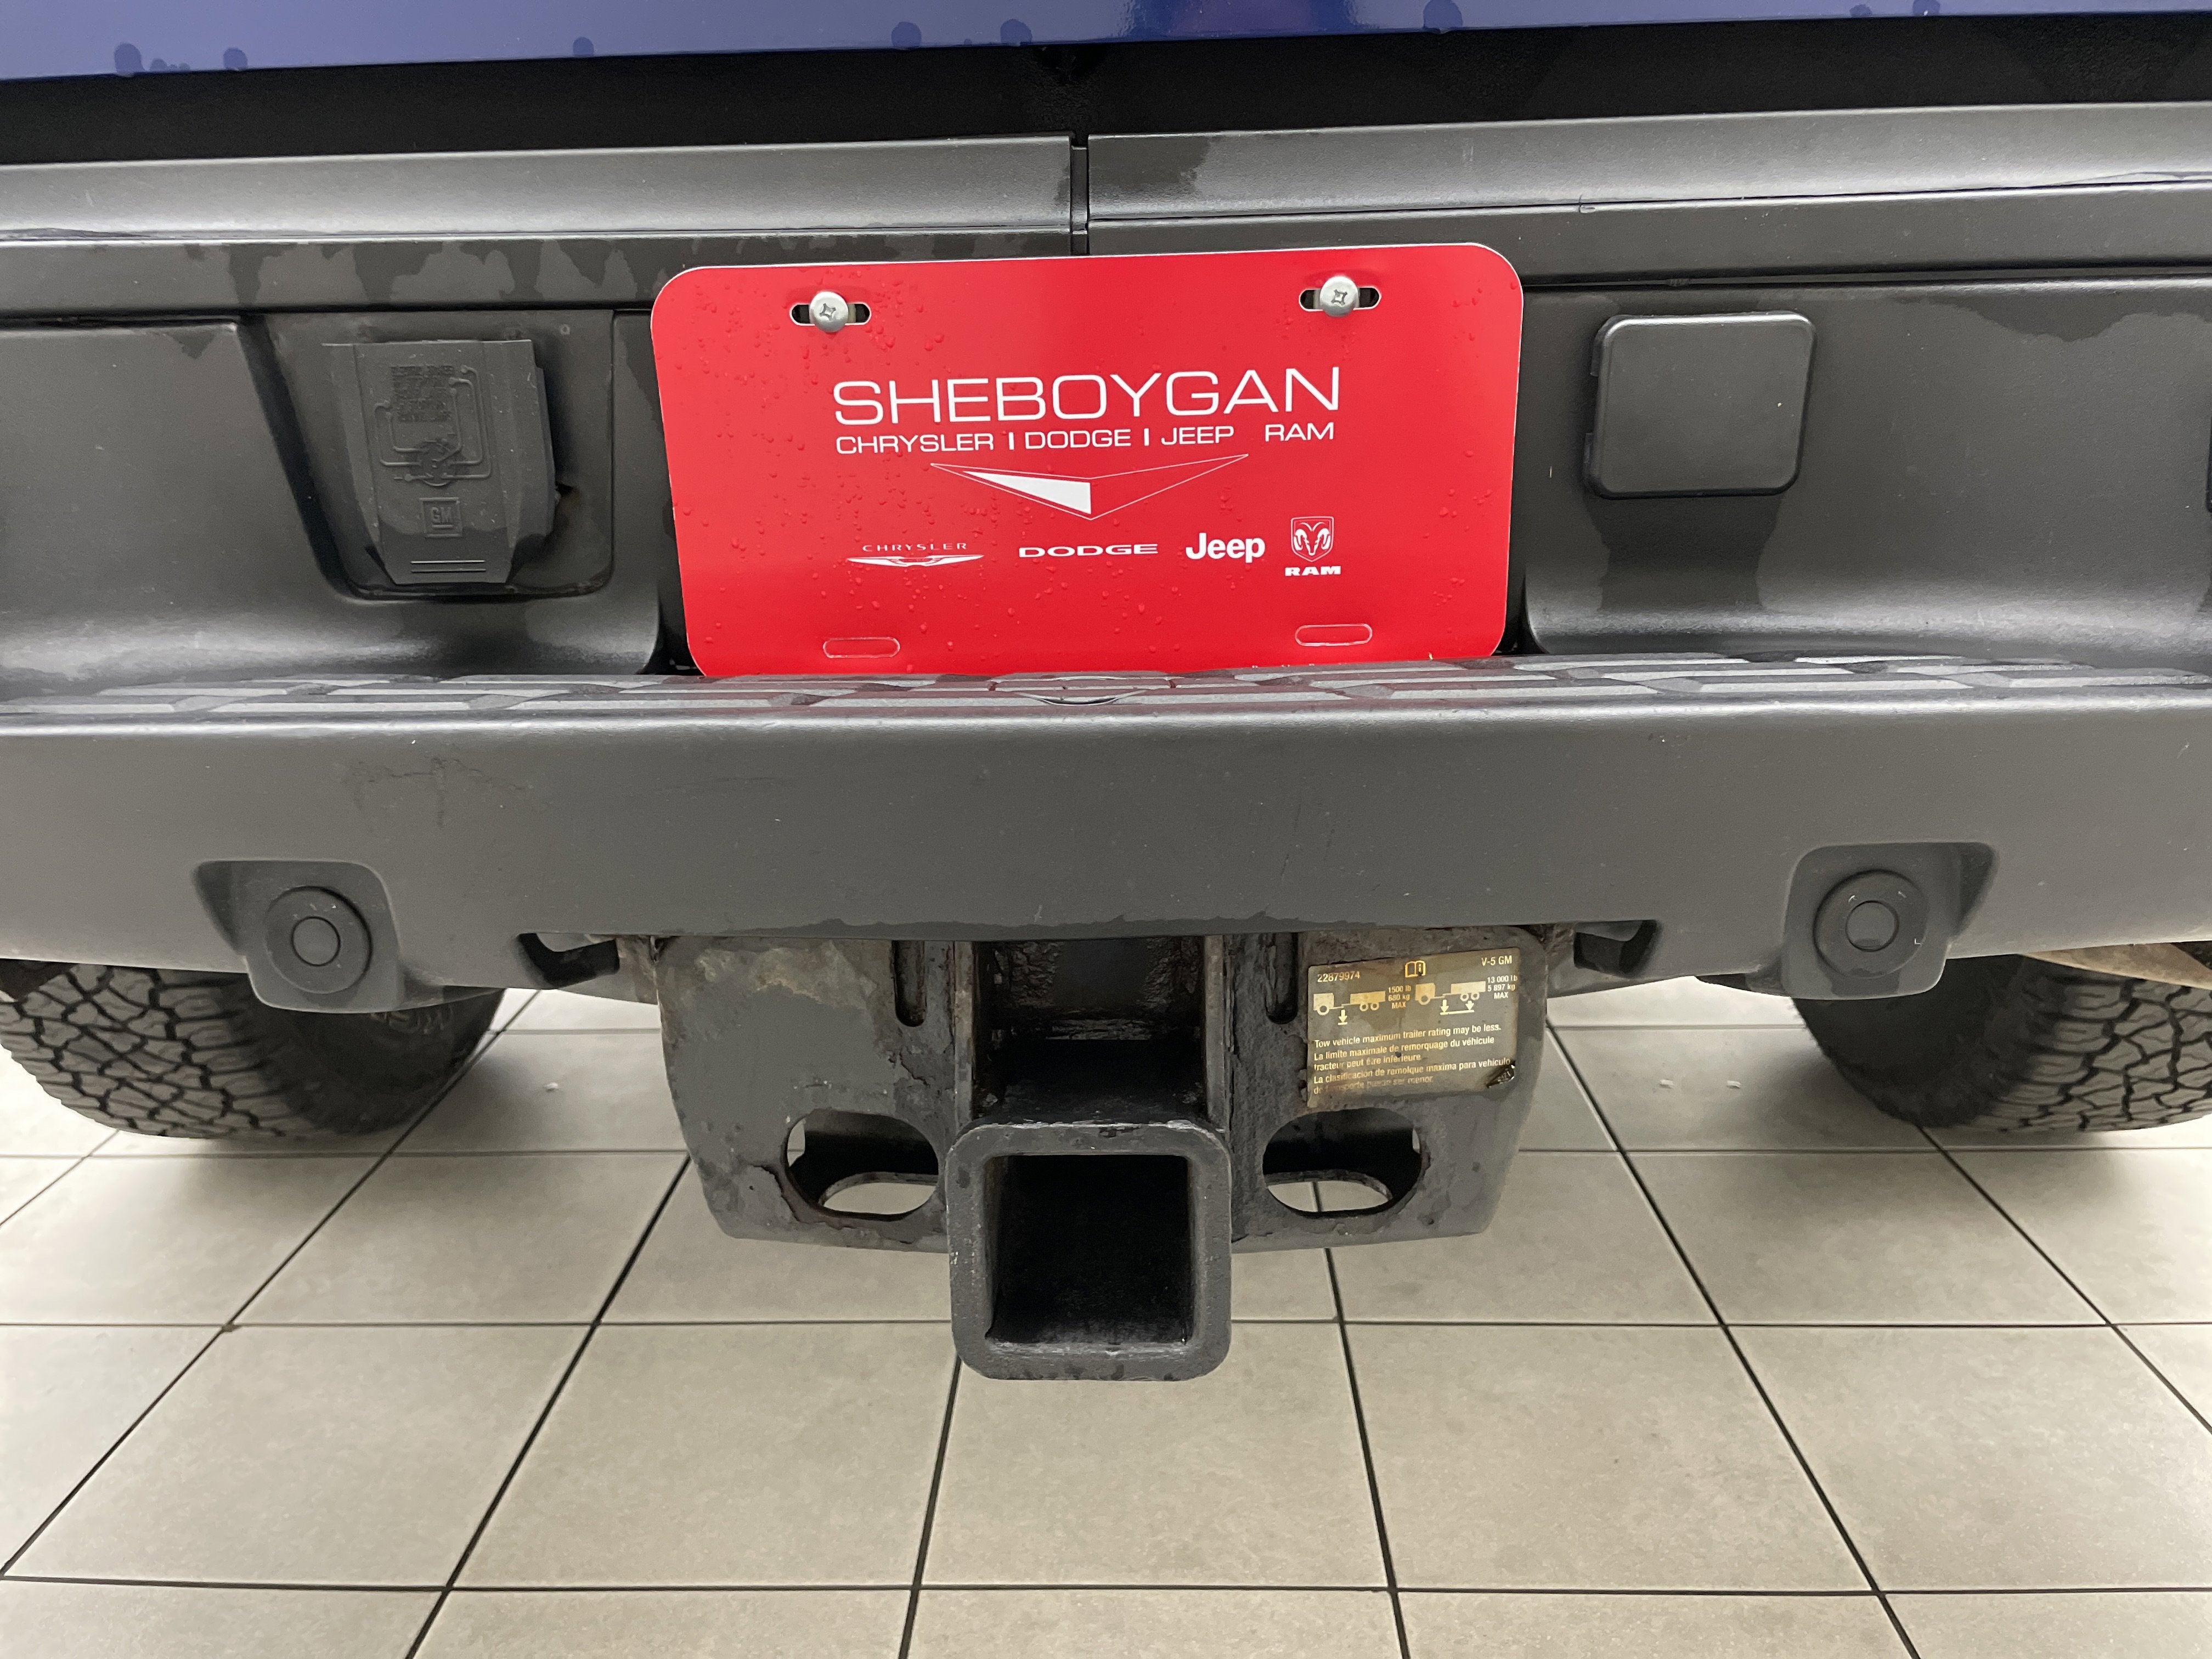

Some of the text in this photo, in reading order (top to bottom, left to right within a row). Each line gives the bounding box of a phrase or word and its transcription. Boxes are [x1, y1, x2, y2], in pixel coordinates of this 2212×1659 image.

[833, 366, 1340, 425] SHEBOYGAN
[836, 422, 1334, 454] CHRYSLER DODGE JEEP RAM
[430, 506, 453, 523] GM
[862, 532, 1265, 563] CHRYSLER DODGE Jeep
[1285, 565, 1341, 577] RAM
[1481, 955, 1513, 967] V-5 GM
[1317, 970, 1361, 983] 22879974
[1388, 985, 1403, 994] 1500
[1507, 983, 1516, 991] kg
[1388, 993, 1410, 1002] 680 kg
[1391, 1001, 1406, 1009] MAX
[1314, 1023, 1502, 1048] Tow vehicle maximum trailer rating may be less.
[1314, 1035, 1494, 1061] La limite maximale de remorquage du véhicule
[1313, 1076, 1323, 1084] La
[1375, 1068, 1385, 1076] de
[1387, 1065, 1424, 1075] remolque
[1459, 1061, 1476, 1071] para
[1314, 1062, 1343, 1071] tracteur
[1346, 1059, 1364, 1069] peut
[1325, 1081, 1364, 1092] tnsporte
[1408, 1075, 1434, 1085] menor
